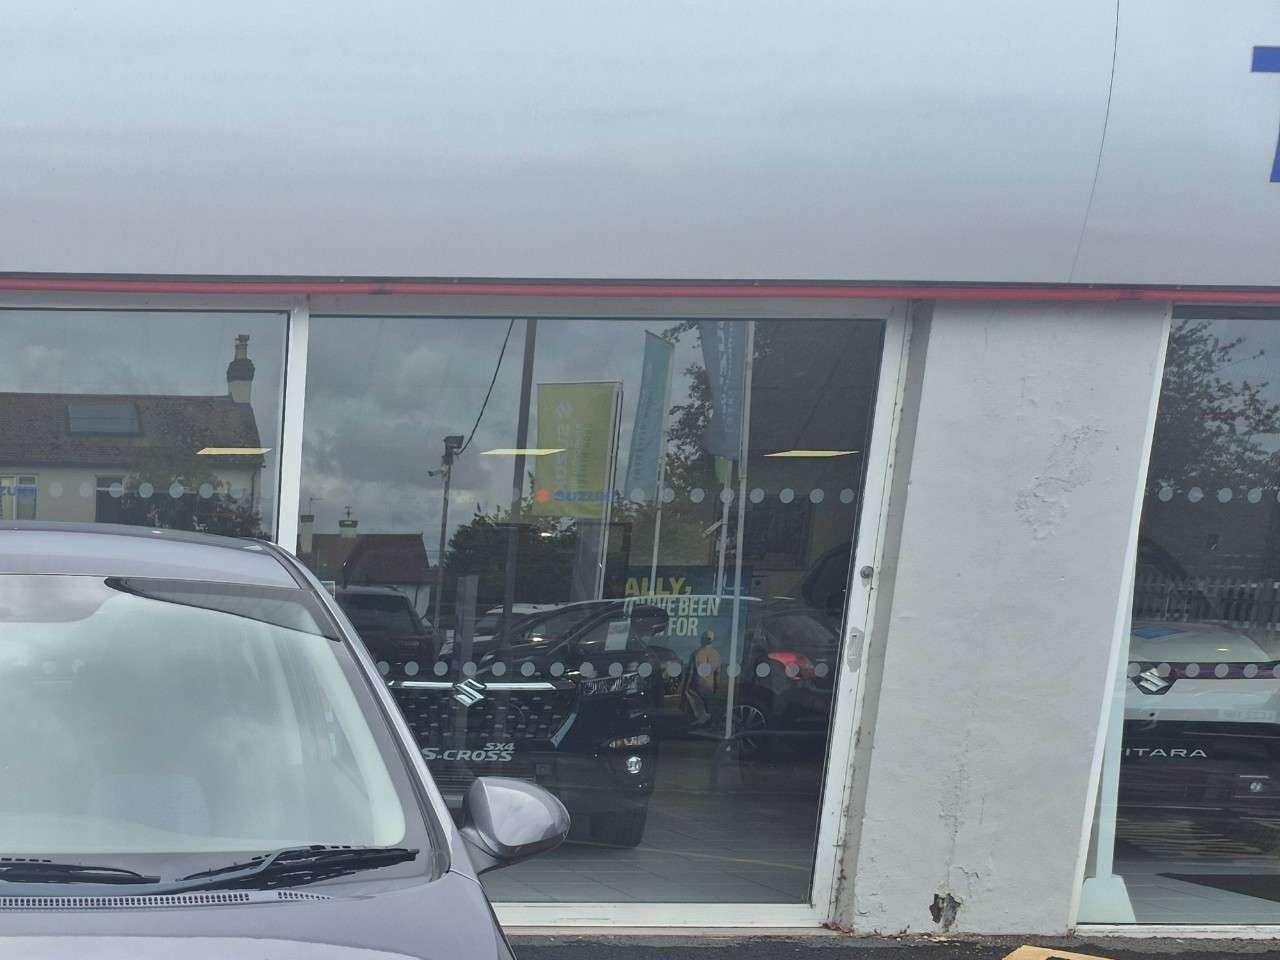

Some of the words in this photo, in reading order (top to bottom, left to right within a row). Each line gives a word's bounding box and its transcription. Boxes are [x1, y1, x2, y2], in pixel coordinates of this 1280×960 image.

[678, 597, 720, 616] BEEN
[668, 619, 698, 636] FOR
[484, 742, 516, 751] SX4
[1123, 748, 1207, 758] ITARA
